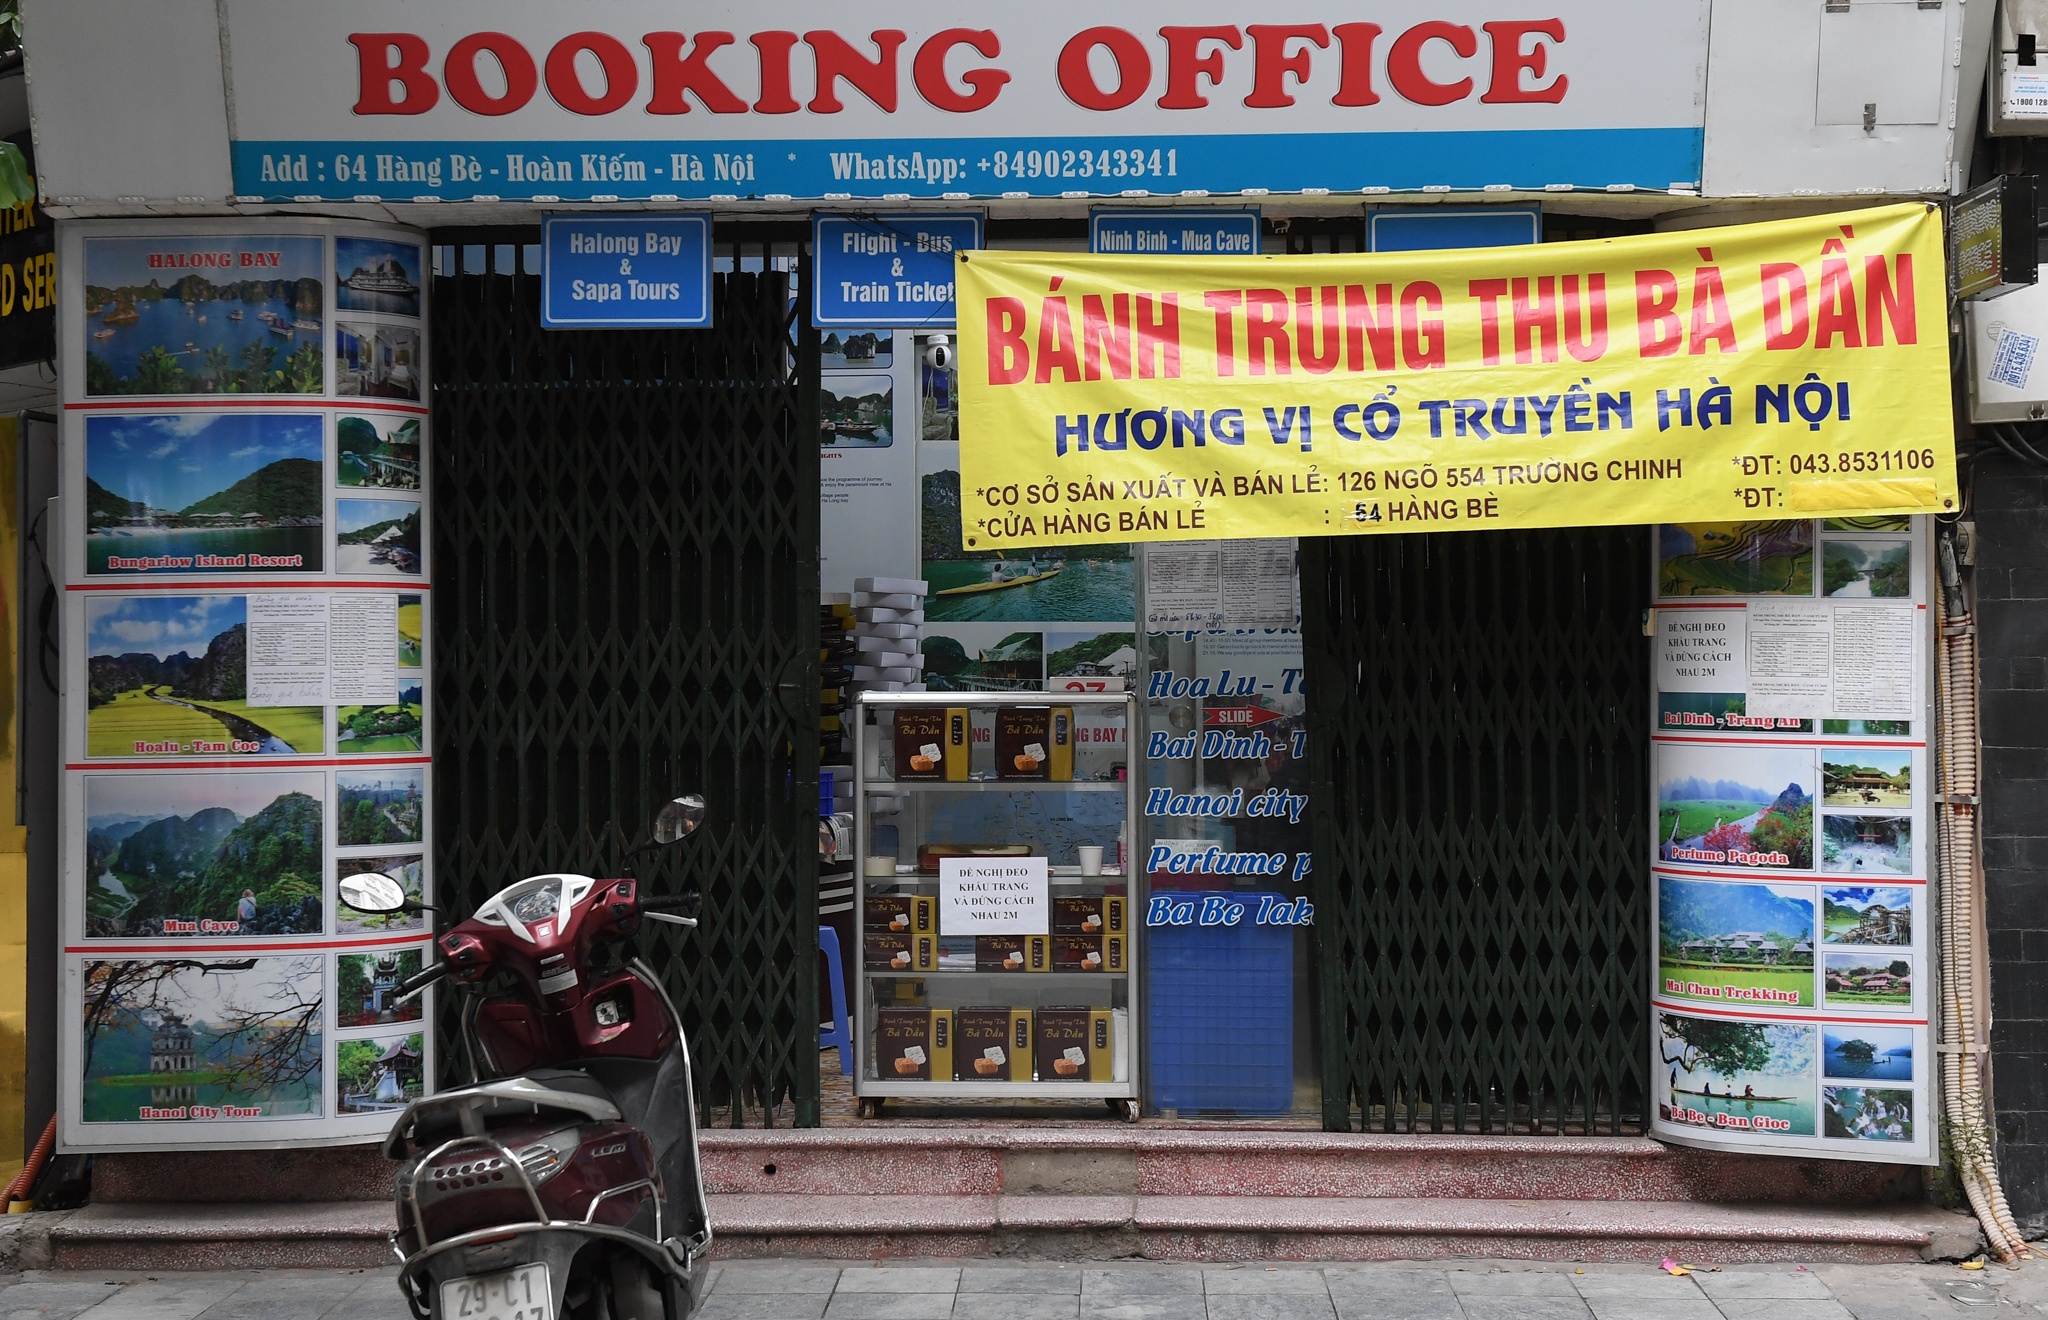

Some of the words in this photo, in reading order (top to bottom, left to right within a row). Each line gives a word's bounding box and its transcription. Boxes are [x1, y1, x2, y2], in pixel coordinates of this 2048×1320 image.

[349, 29, 1011, 116] BOOKING
[1056, 18, 1568, 111] OFFICE
[261, 154, 307, 182] Add
[334, 155, 367, 182] 64
[376, 154, 441, 187] Hàng
[450, 154, 482, 182] Bè
[507, 154, 573, 182] Hoàn
[580, 153, 646, 182] Kiếm
[671, 154, 705, 182] Hà
[714, 153, 755, 185] Nội
[830, 151, 966, 183] WhatsApp:
[977, 148, 1178, 178] +84902343341
[570, 232, 642, 258] Halong
[646, 232, 682, 258] Bay
[843, 231, 897, 258] Flight
[917, 232, 953, 253] Bus
[1100, 231, 1132, 252] Ninh
[1137, 231, 1168, 252] Binh
[1182, 231, 1212, 252] Mua
[1216, 231, 1250, 252] Cave
[149, 252, 232, 269] HALONG
[239, 252, 281, 268] BAY
[619, 259, 632, 275] &
[891, 258, 904, 276] &
[572, 280, 623, 305] Sapa
[627, 280, 680, 300] Tours
[841, 281, 890, 303] Train
[895, 280, 955, 303] Ticket
[986, 276, 1182, 385] BÁNH
[1204, 280, 1446, 378] TRUNG
[1468, 272, 1608, 367] THU
[1635, 247, 1739, 359] BÀ
[1760, 224, 1917, 351] DẦN
[1056, 405, 1245, 458] HƯƠNG
[1263, 406, 1313, 453] VỊ
[1333, 385, 1401, 443] CỔ
[1418, 377, 1633, 442] TRUYỀN
[1656, 376, 1733, 433] HÀ
[1755, 372, 1851, 432] NỘI
[1790, 448, 1936, 475] 043.8531106
[1027, 475, 1060, 506] SỞ
[1067, 474, 1116, 504] SẢN
[1123, 471, 1188, 501] XUẤT
[1194, 471, 1226, 499] VÀ
[1233, 471, 1284, 497] BÁN
[1292, 465, 1330, 494] LẺ:
[1337, 470, 1376, 492] 126
[1383, 463, 1439, 489] NGÕ
[1446, 466, 1486, 487] 554
[1498, 458, 1600, 485] TRƯỜNG
[1606, 458, 1683, 481] CHINH
[1044, 505, 1111, 535] HÀNG
[1118, 506, 1169, 531] BÁN
[1177, 500, 1206, 530] LẺ
[1387, 498, 1459, 522] HÀNG
[1466, 491, 1499, 519] BÈ
[109, 555, 191, 571] Bungarlow
[196, 554, 246, 568] Island
[250, 553, 303, 568] Resort
[1680, 623, 1702, 633] NGHỊ
[1704, 623, 1726, 631] ĐEO
[1692, 638, 1726, 646] TRANG
[1703, 651, 1731, 661] CÁCH
[1676, 668, 1699, 676] NHAU
[1701, 668, 1715, 676] 2M
[1148, 671, 1210, 699] Hoa
[1216, 669, 1257, 697] Lu
[1219, 710, 1253, 723] SLIDE
[1665, 713, 1681, 724] Bai
[1683, 713, 1714, 726] Dinh
[1726, 714, 1774, 728] Trang
[1777, 715, 1800, 727] An
[900, 725, 916, 734] Bà
[1004, 725, 1019, 734] Bà
[1093, 727, 1117, 742] BAY
[134, 740, 179, 753] Hoalu
[193, 740, 226, 753] Tam
[230, 739, 260, 752] Coc
[1147, 730, 1197, 760] Bai
[1201, 730, 1270, 759] Dinh
[1146, 788, 1244, 816] Hanoi
[1247, 788, 1308, 824] city
[1147, 845, 1287, 875] Perfume
[1671, 846, 1724, 861] Perfume
[1728, 849, 1789, 866] Pagoda
[976, 868, 1003, 878] NGHỊ
[1006, 868, 1028, 876] ĐEO
[992, 882, 1029, 891] TRANG
[954, 895, 968, 905] VÀ
[971, 895, 1001, 905] ĐỨNG
[1004, 895, 1034, 905] CÁCH
[971, 911, 1000, 920] NHAU
[1003, 911, 1018, 919] 2M
[1147, 897, 1195, 926] Ba
[1200, 897, 1244, 926] Be
[1256, 896, 1314, 926] lak
[163, 920, 198, 932] Mua
[201, 919, 239, 932] Cave
[1666, 979, 1685, 992] Mai
[1688, 982, 1721, 997] Chau
[1724, 986, 1798, 1003] Trekking
[885, 1028, 900, 1037] Bà
[965, 1028, 979, 1037] Bà
[1044, 1029, 1059, 1037] Bà
[139, 1106, 186, 1119] Hanoi
[189, 1105, 219, 1120] City
[223, 1105, 261, 1118] Tour
[1671, 1107, 1686, 1120] Ba
[1688, 1110, 1704, 1122] Be
[1717, 1115, 1748, 1127] Ban
[1753, 1116, 1790, 1130] Gioc
